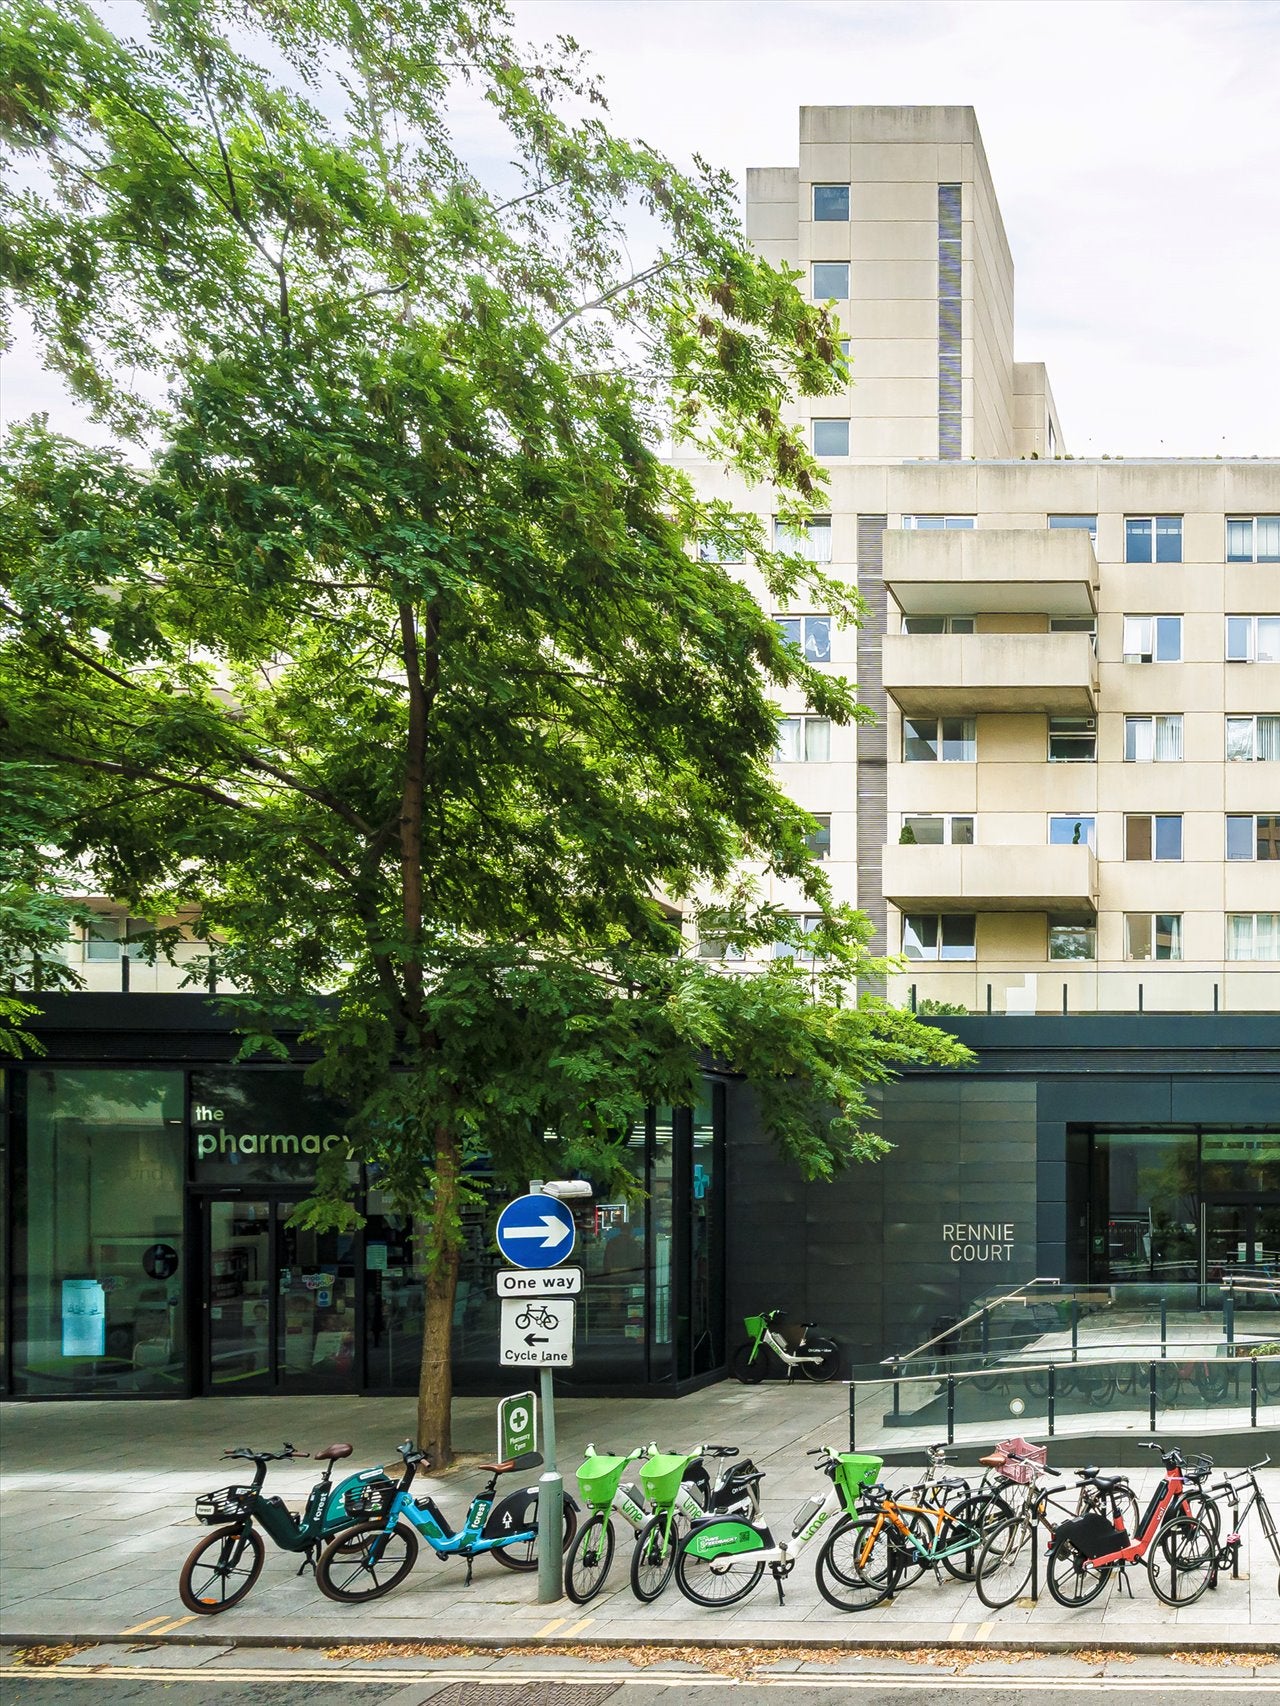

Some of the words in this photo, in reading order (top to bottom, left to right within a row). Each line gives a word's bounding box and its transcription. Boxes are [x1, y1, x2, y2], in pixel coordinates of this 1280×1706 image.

[195, 1106, 224, 1121] the
[943, 1224, 1014, 1241] RENNIE
[951, 1244, 1014, 1261] COURT
[504, 1277, 537, 1289] One
[543, 1278, 575, 1289] way
[505, 1350, 537, 1361] Cycle
[542, 1351, 568, 1360] lane
[313, 1493, 328, 1521] forest
[471, 1503, 487, 1528] forest
